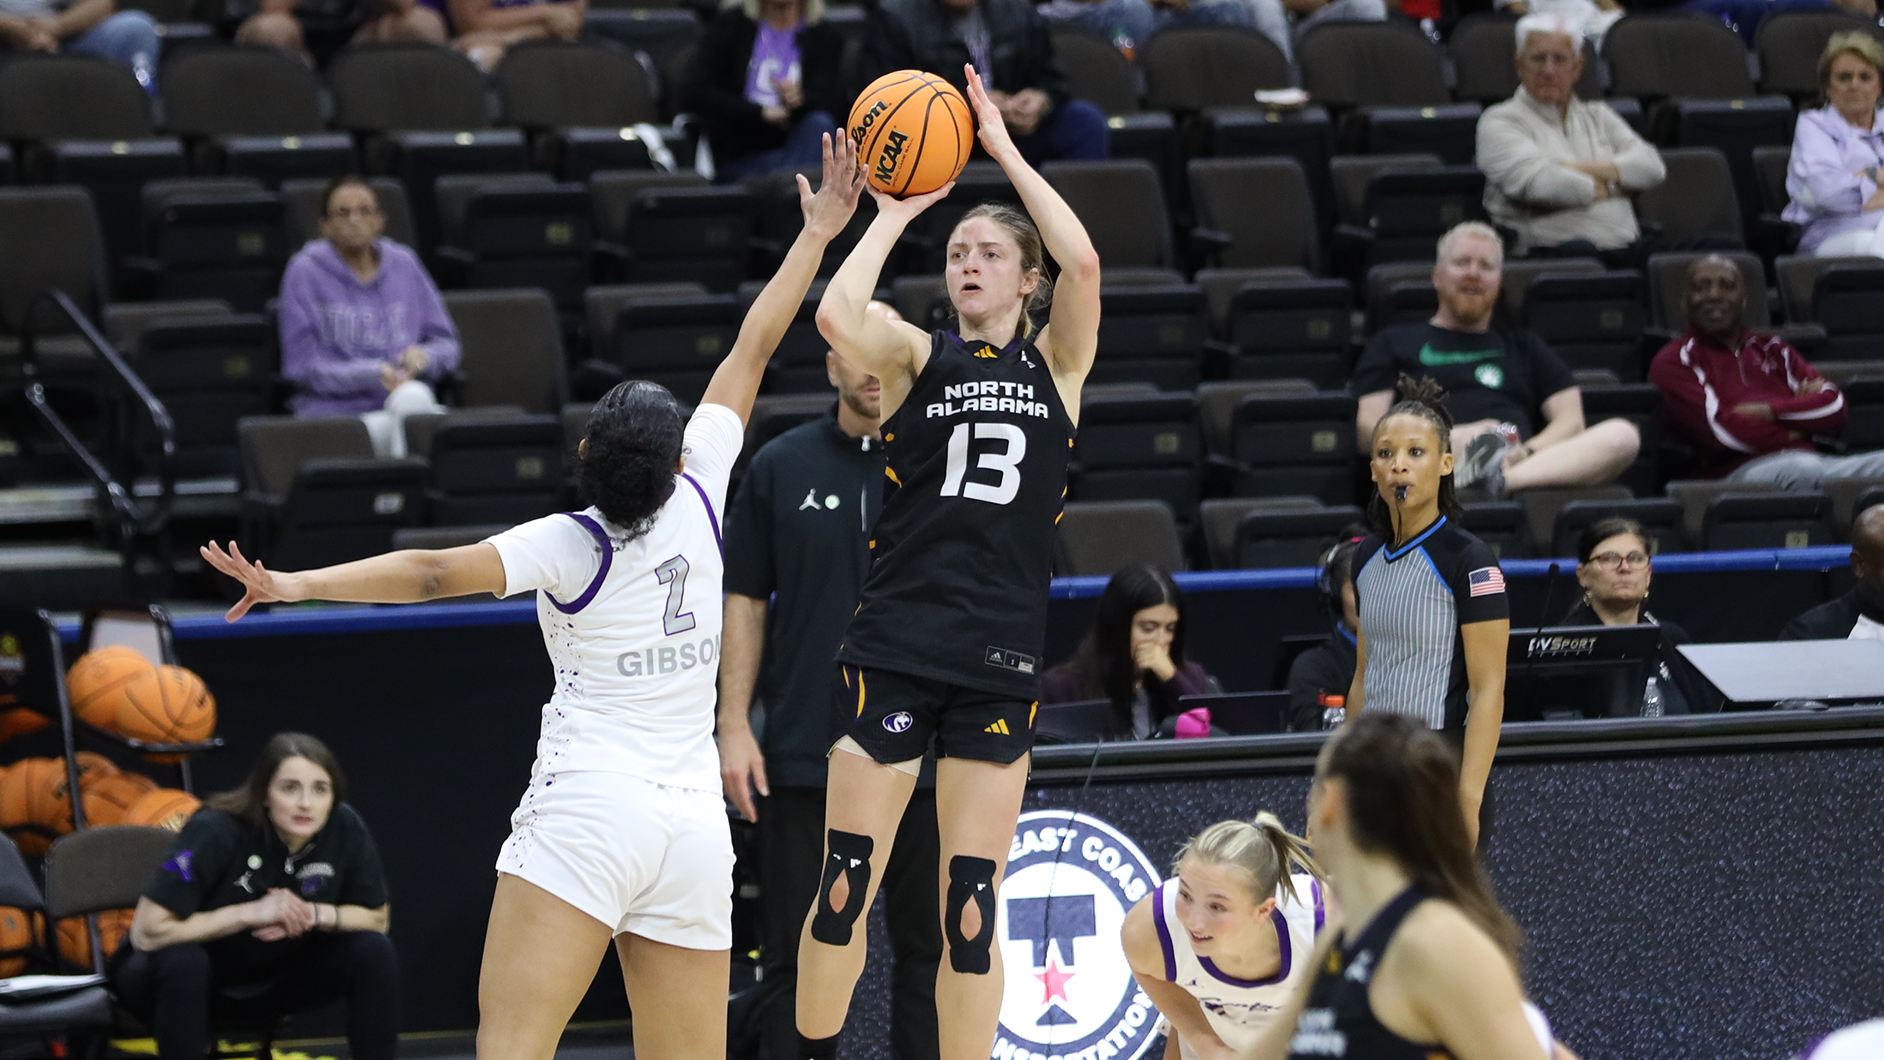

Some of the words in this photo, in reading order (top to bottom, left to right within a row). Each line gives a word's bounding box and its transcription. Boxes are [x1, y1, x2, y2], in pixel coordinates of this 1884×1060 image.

[851, 101, 888, 164] lson
[875, 129, 908, 186] NCAA
[926, 397, 1049, 419] ALABAMA
[945, 381, 1034, 400] NORTH
[939, 422, 1027, 505] 13
[655, 554, 696, 636] 2
[1081, 836, 1148, 902] COAS
